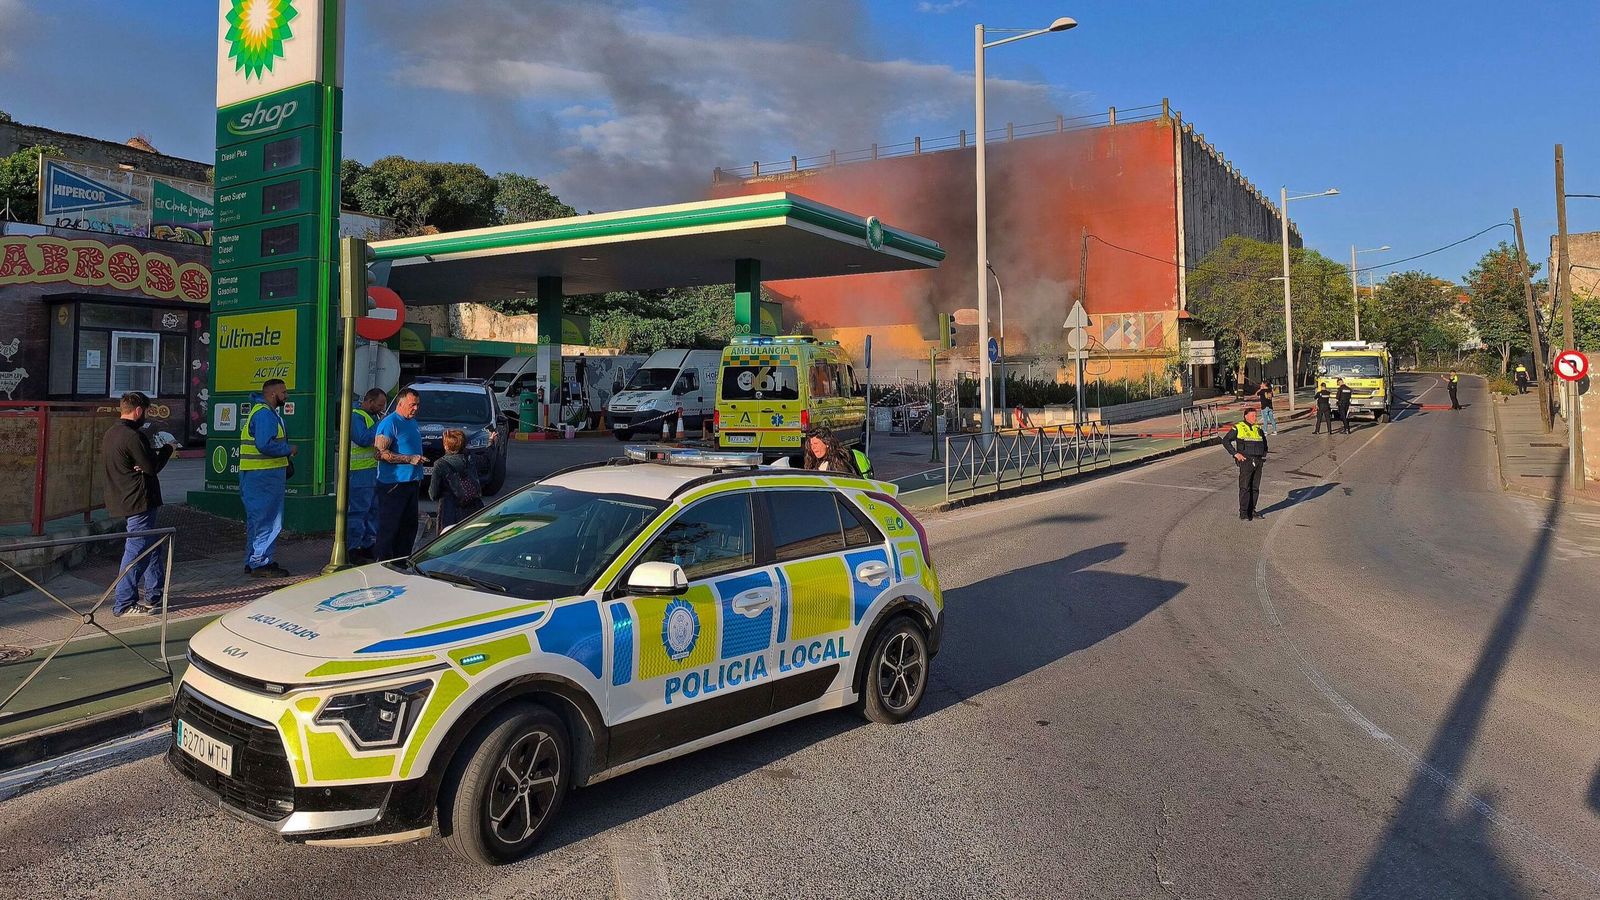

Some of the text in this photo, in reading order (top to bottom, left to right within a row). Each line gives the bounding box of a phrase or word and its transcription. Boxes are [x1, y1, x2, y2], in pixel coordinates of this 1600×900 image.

[240, 100, 298, 130] shop
[221, 150, 248, 162] Diesel Plus
[53, 184, 106, 203] HIPERCOR
[220, 191, 247, 203] Euro Super
[218, 235, 240, 243] Ultimate
[218, 245, 234, 254] Diesel
[217, 276, 239, 285] Ultimate
[217, 287, 239, 296] Gasolina
[219, 326, 281, 350] ultimate
[731, 346, 790, 356] AMBULANCIA
[254, 366, 290, 378] ACTIVE
[231, 446, 240, 458] 24
[664, 636, 851, 704] POLICIA LOCAL
[183, 727, 229, 770] 6270 MTH
